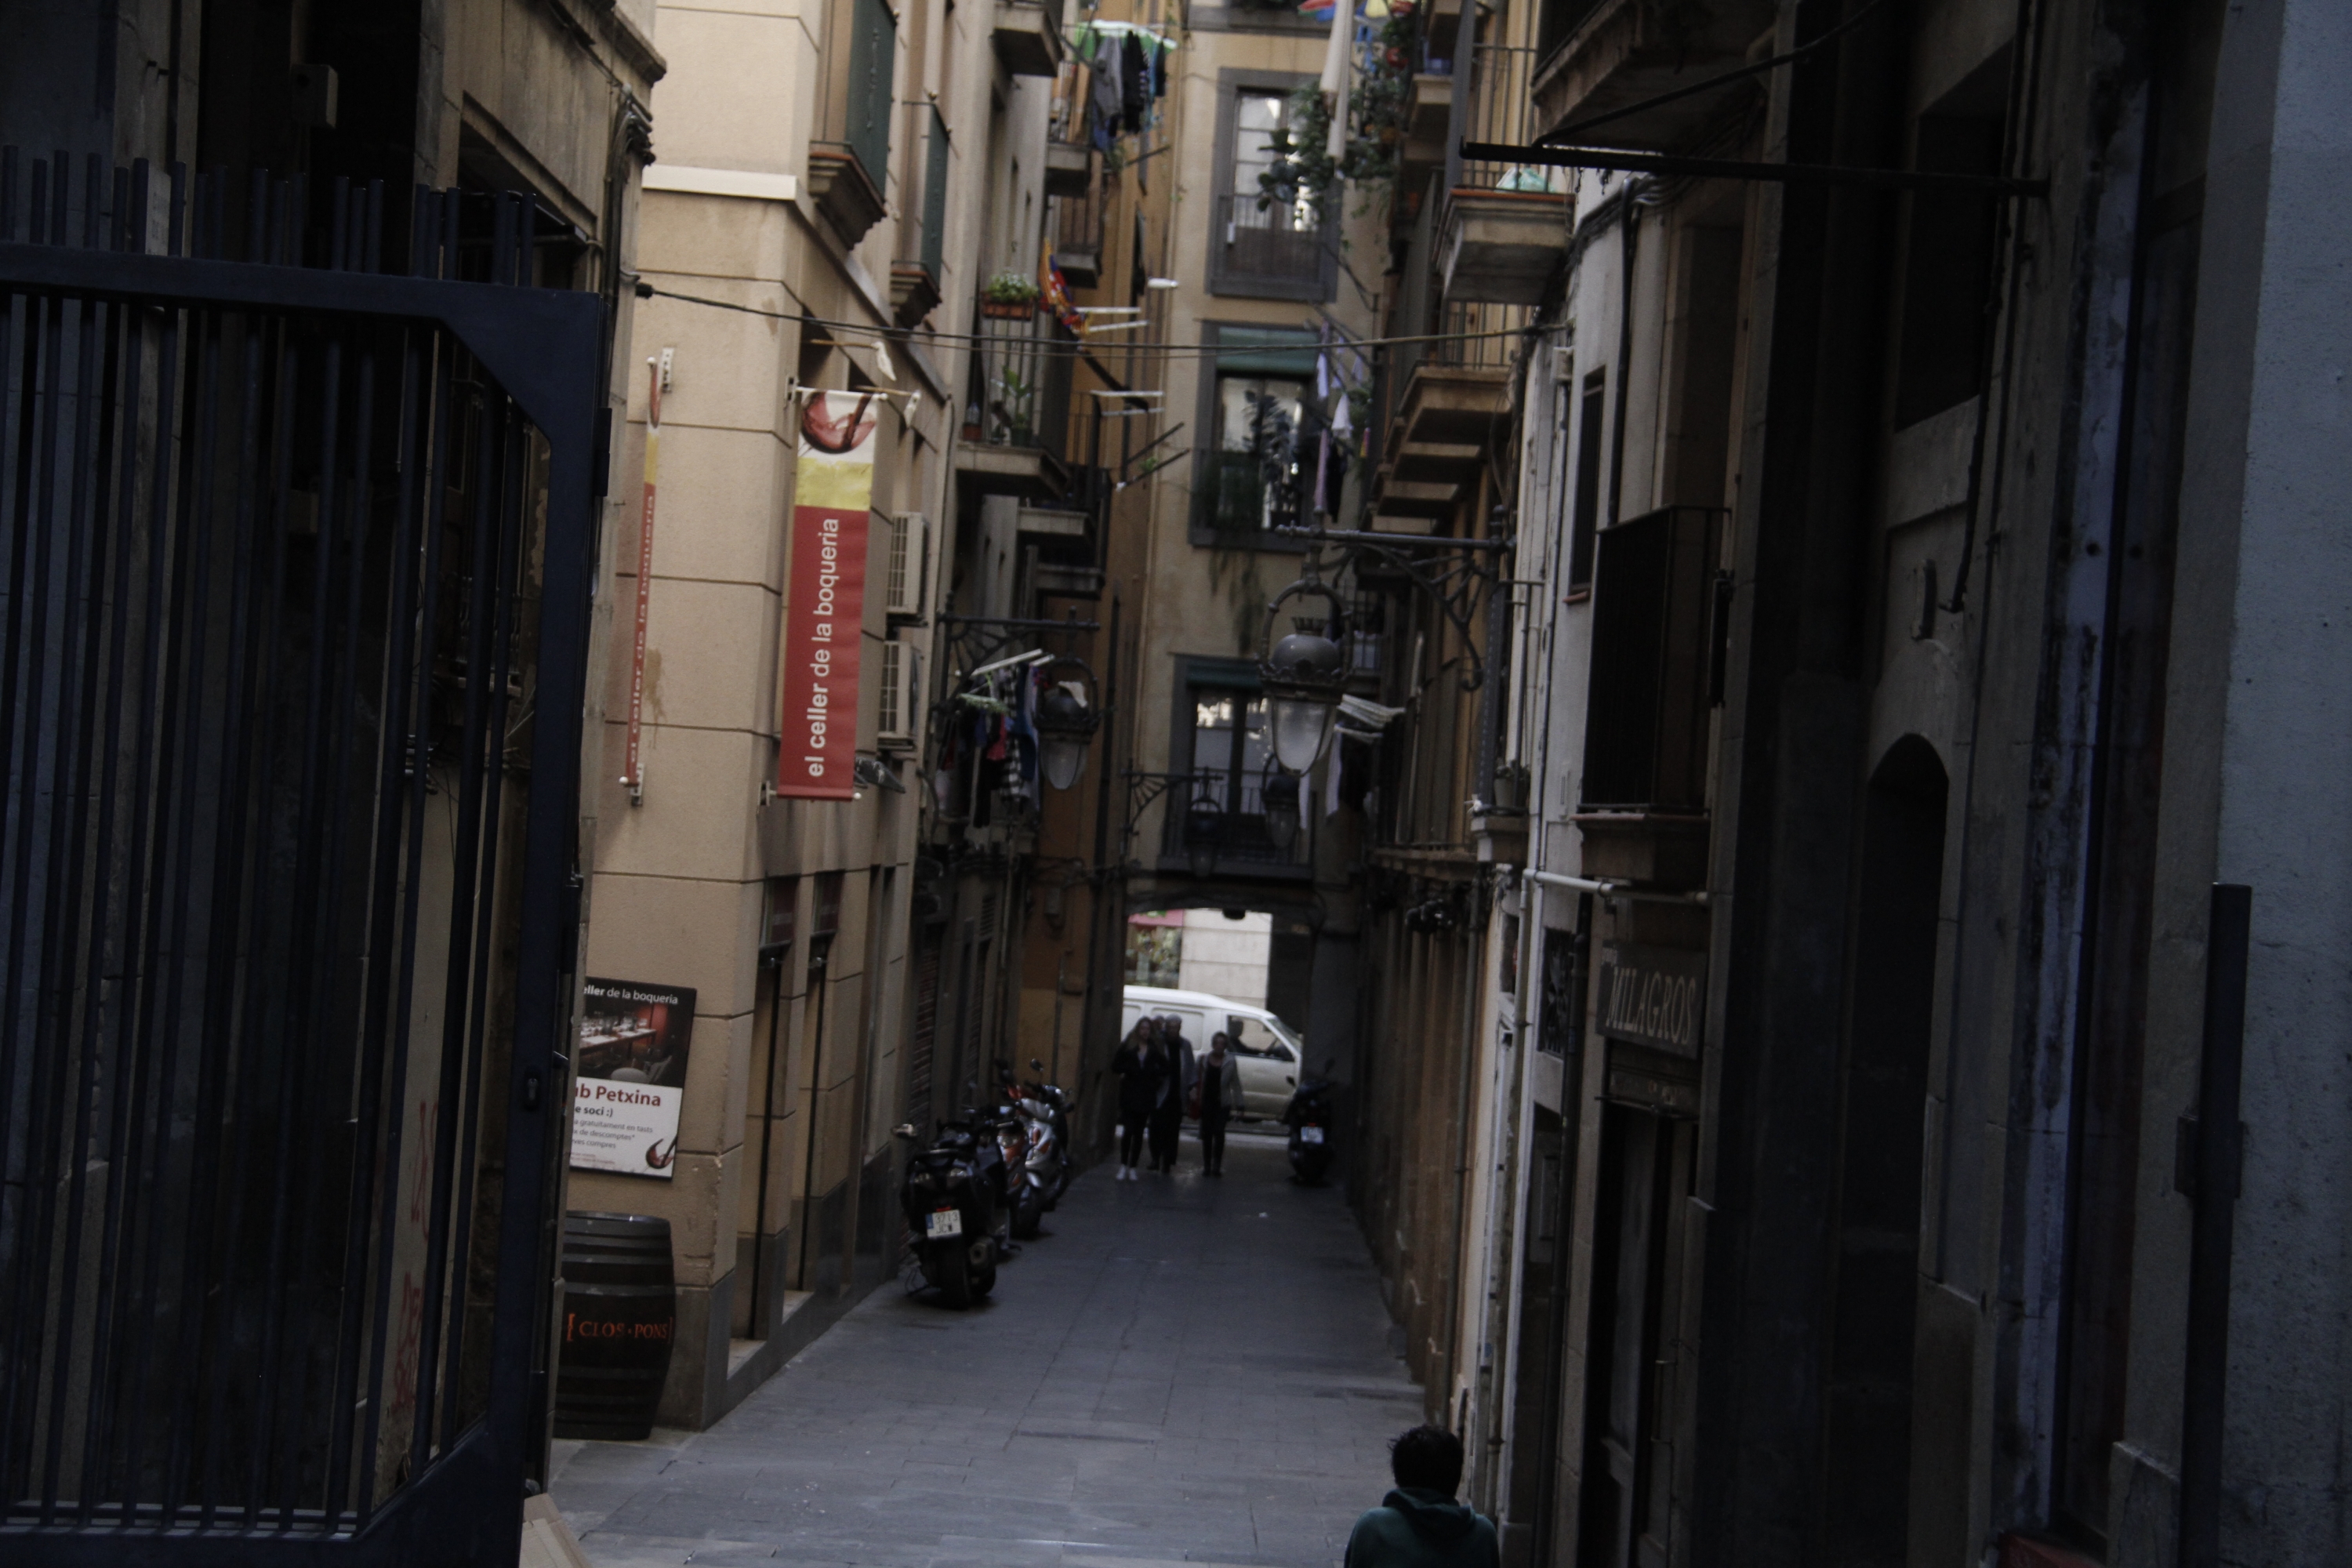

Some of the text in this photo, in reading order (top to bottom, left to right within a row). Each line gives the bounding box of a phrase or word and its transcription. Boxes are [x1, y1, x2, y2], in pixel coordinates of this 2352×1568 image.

[804, 518, 840, 777] el celler de la boqueria
[607, 988, 620, 999] de
[622, 989, 631, 1000] la
[633, 989, 679, 1005] boqueria
[1606, 966, 1696, 1045] MILAGROS
[596, 1085, 661, 1106] Petxina
[584, 1106, 604, 1116] soci
